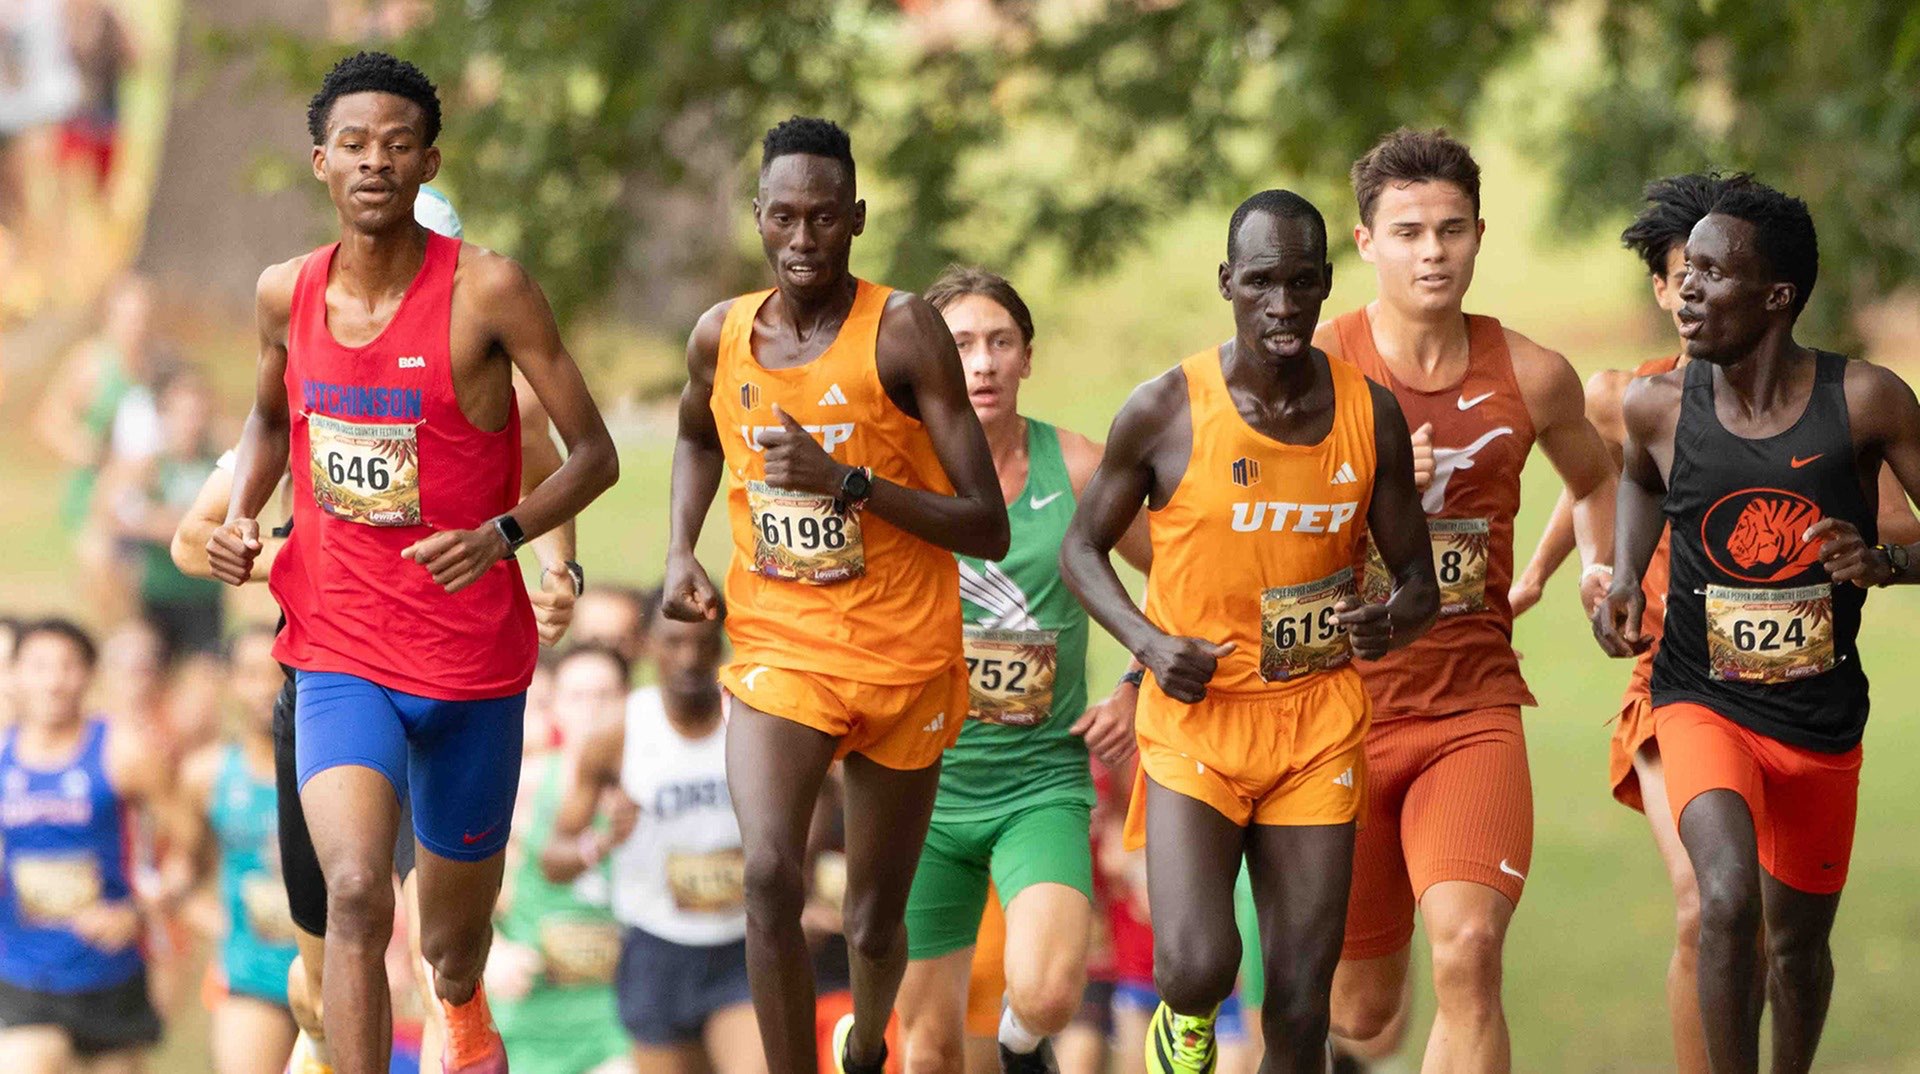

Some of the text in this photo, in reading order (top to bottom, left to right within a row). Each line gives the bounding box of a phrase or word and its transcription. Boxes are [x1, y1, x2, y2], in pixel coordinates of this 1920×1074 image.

[398, 356, 425, 368] BOA
[355, 426, 378, 437] COUNTRY
[379, 427, 404, 437] FESTIVAL
[328, 451, 390, 490] 646
[762, 513, 846, 549] 6198
[1231, 501, 1358, 533] UTEP
[1731, 591, 1751, 601] PEPPER
[1752, 592, 1769, 601] CROSS
[1771, 591, 1795, 601] COUNTRY
[1275, 606, 1347, 650] 619
[1733, 617, 1806, 651] 624
